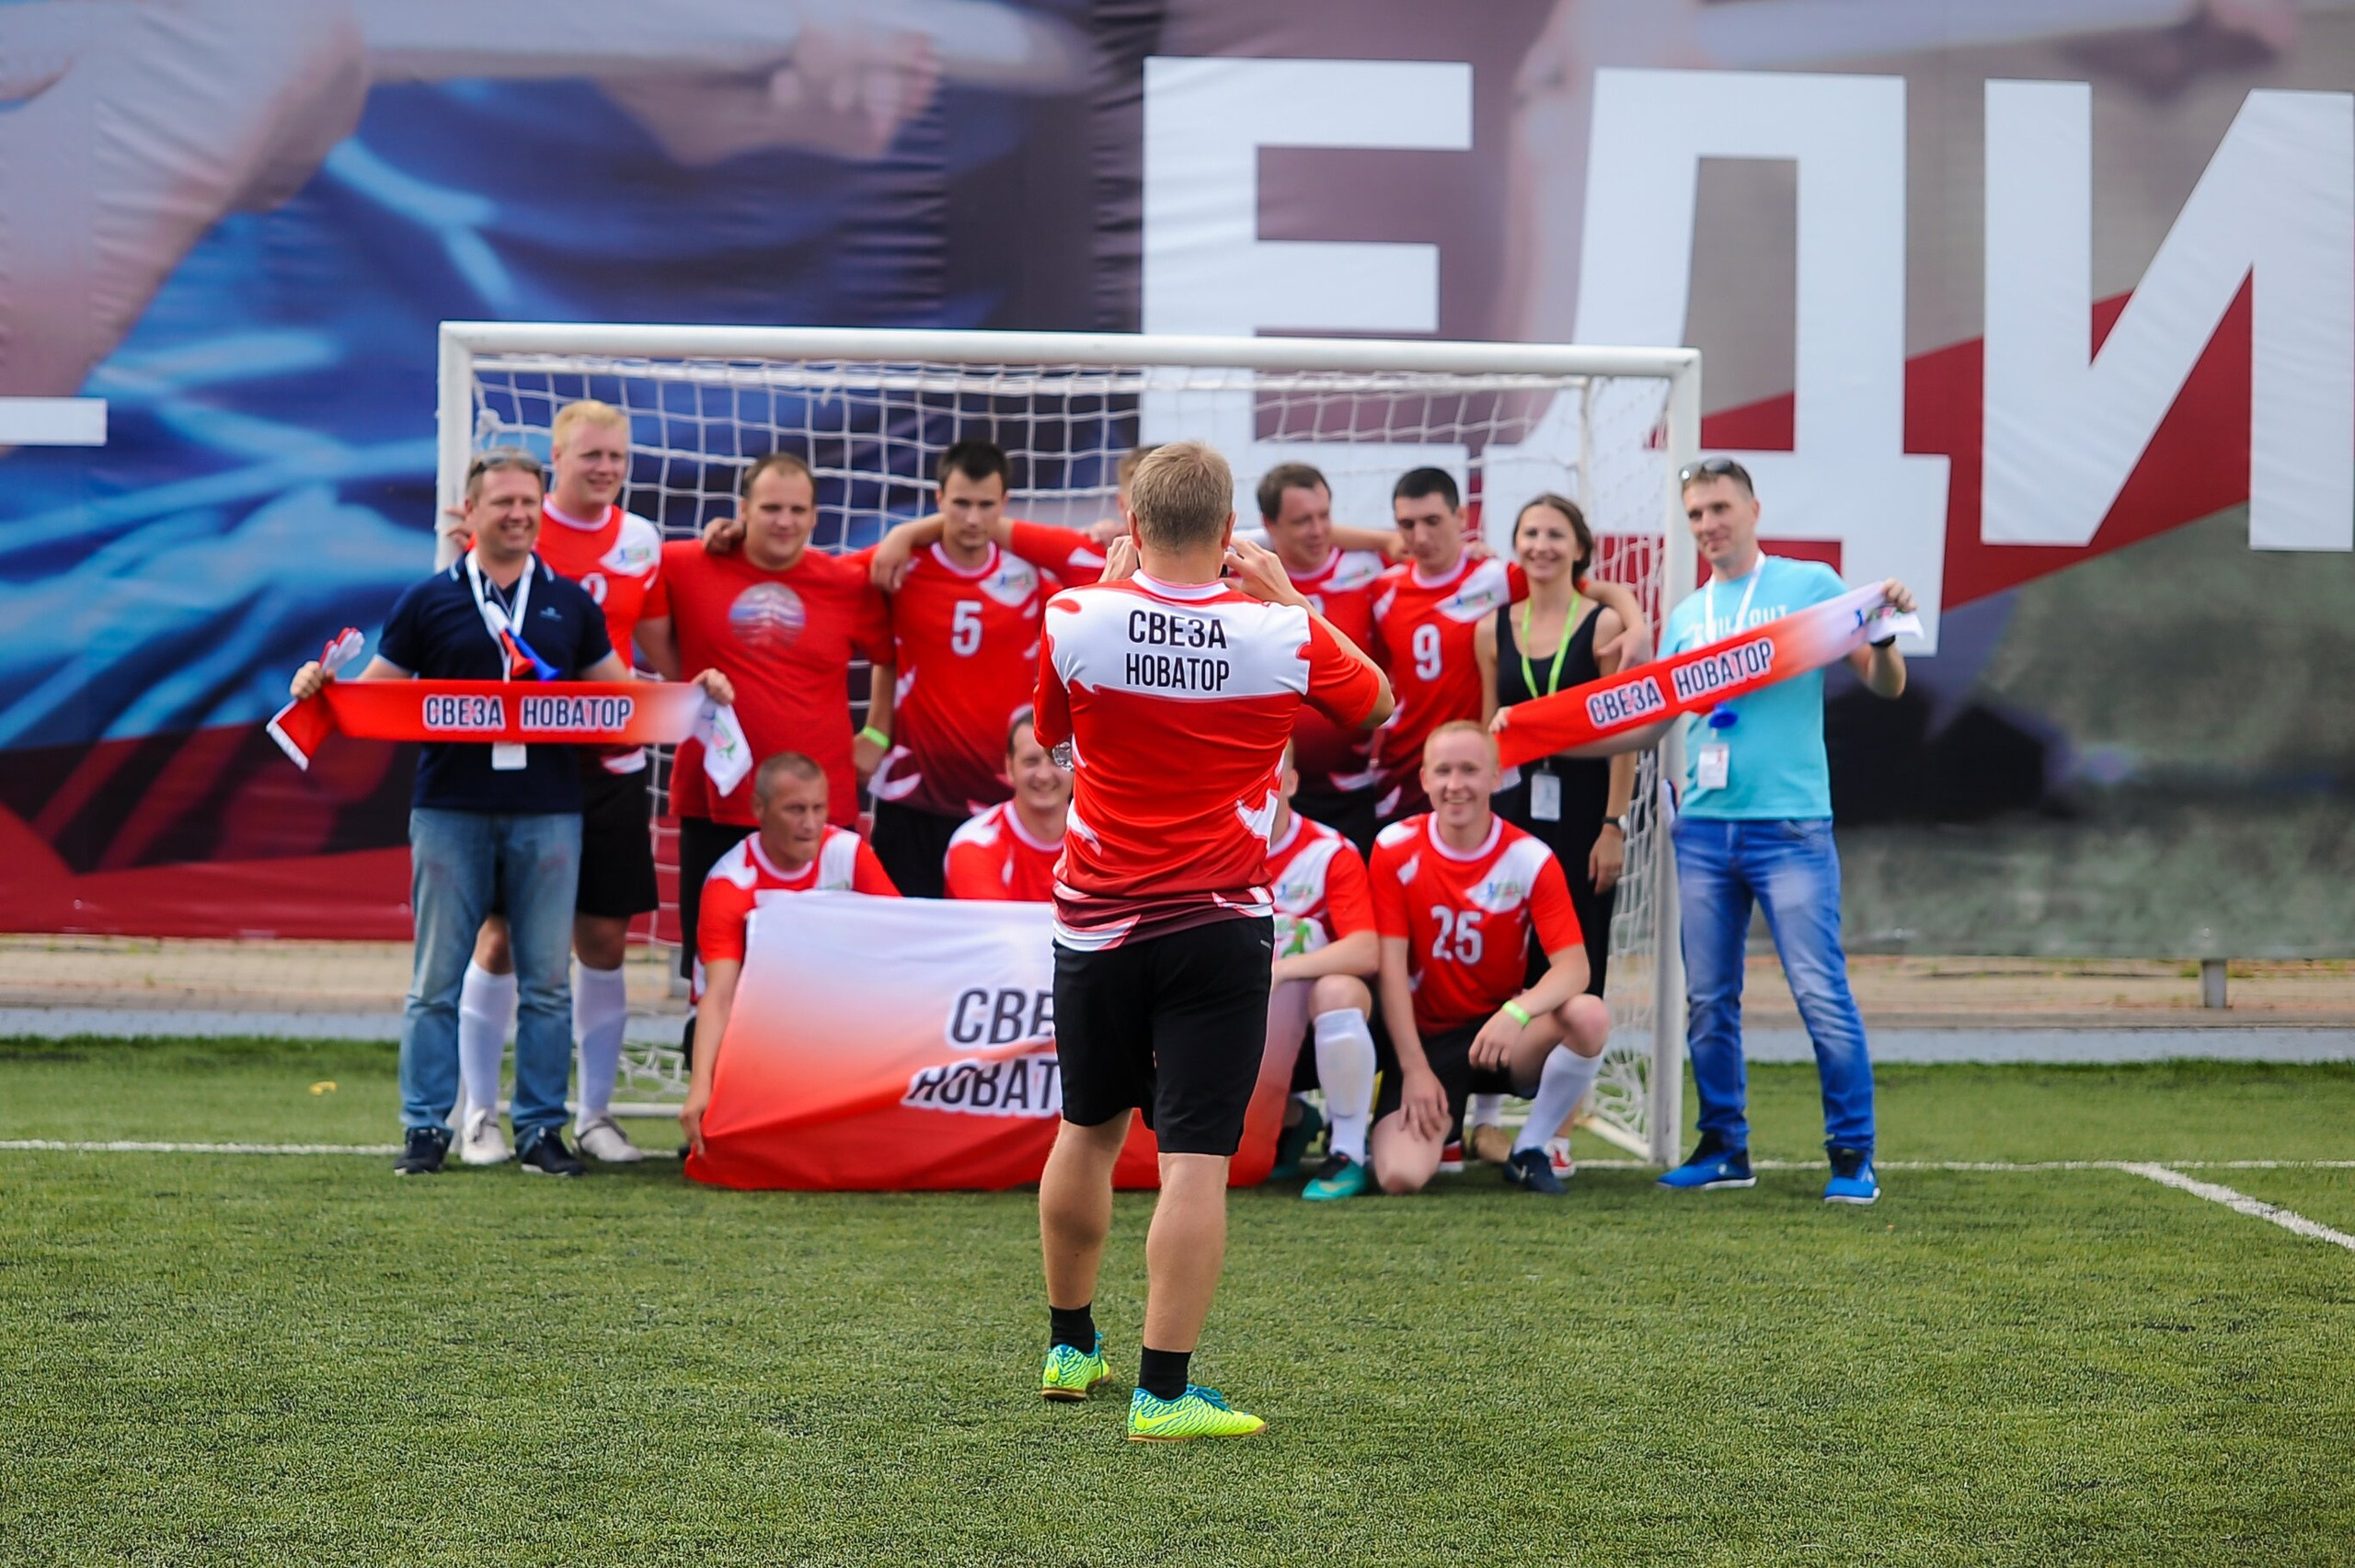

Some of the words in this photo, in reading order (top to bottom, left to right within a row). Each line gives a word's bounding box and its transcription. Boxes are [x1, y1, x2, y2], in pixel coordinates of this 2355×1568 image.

[951, 600, 983, 658] 5
[1128, 609, 1228, 649] СВЕЗА
[1412, 624, 1442, 681] 9
[1126, 652, 1230, 692] НОВАТОР
[1588, 679, 1663, 726] СВЕЗА
[1671, 640, 1774, 699] НОВАТОР
[425, 696, 504, 727] СВЕЗА
[522, 697, 632, 728] НОВАТОР
[1430, 904, 1484, 967] 25
[950, 987, 1055, 1046] СВЕ
[906, 1058, 1062, 1111] НОВАТ
